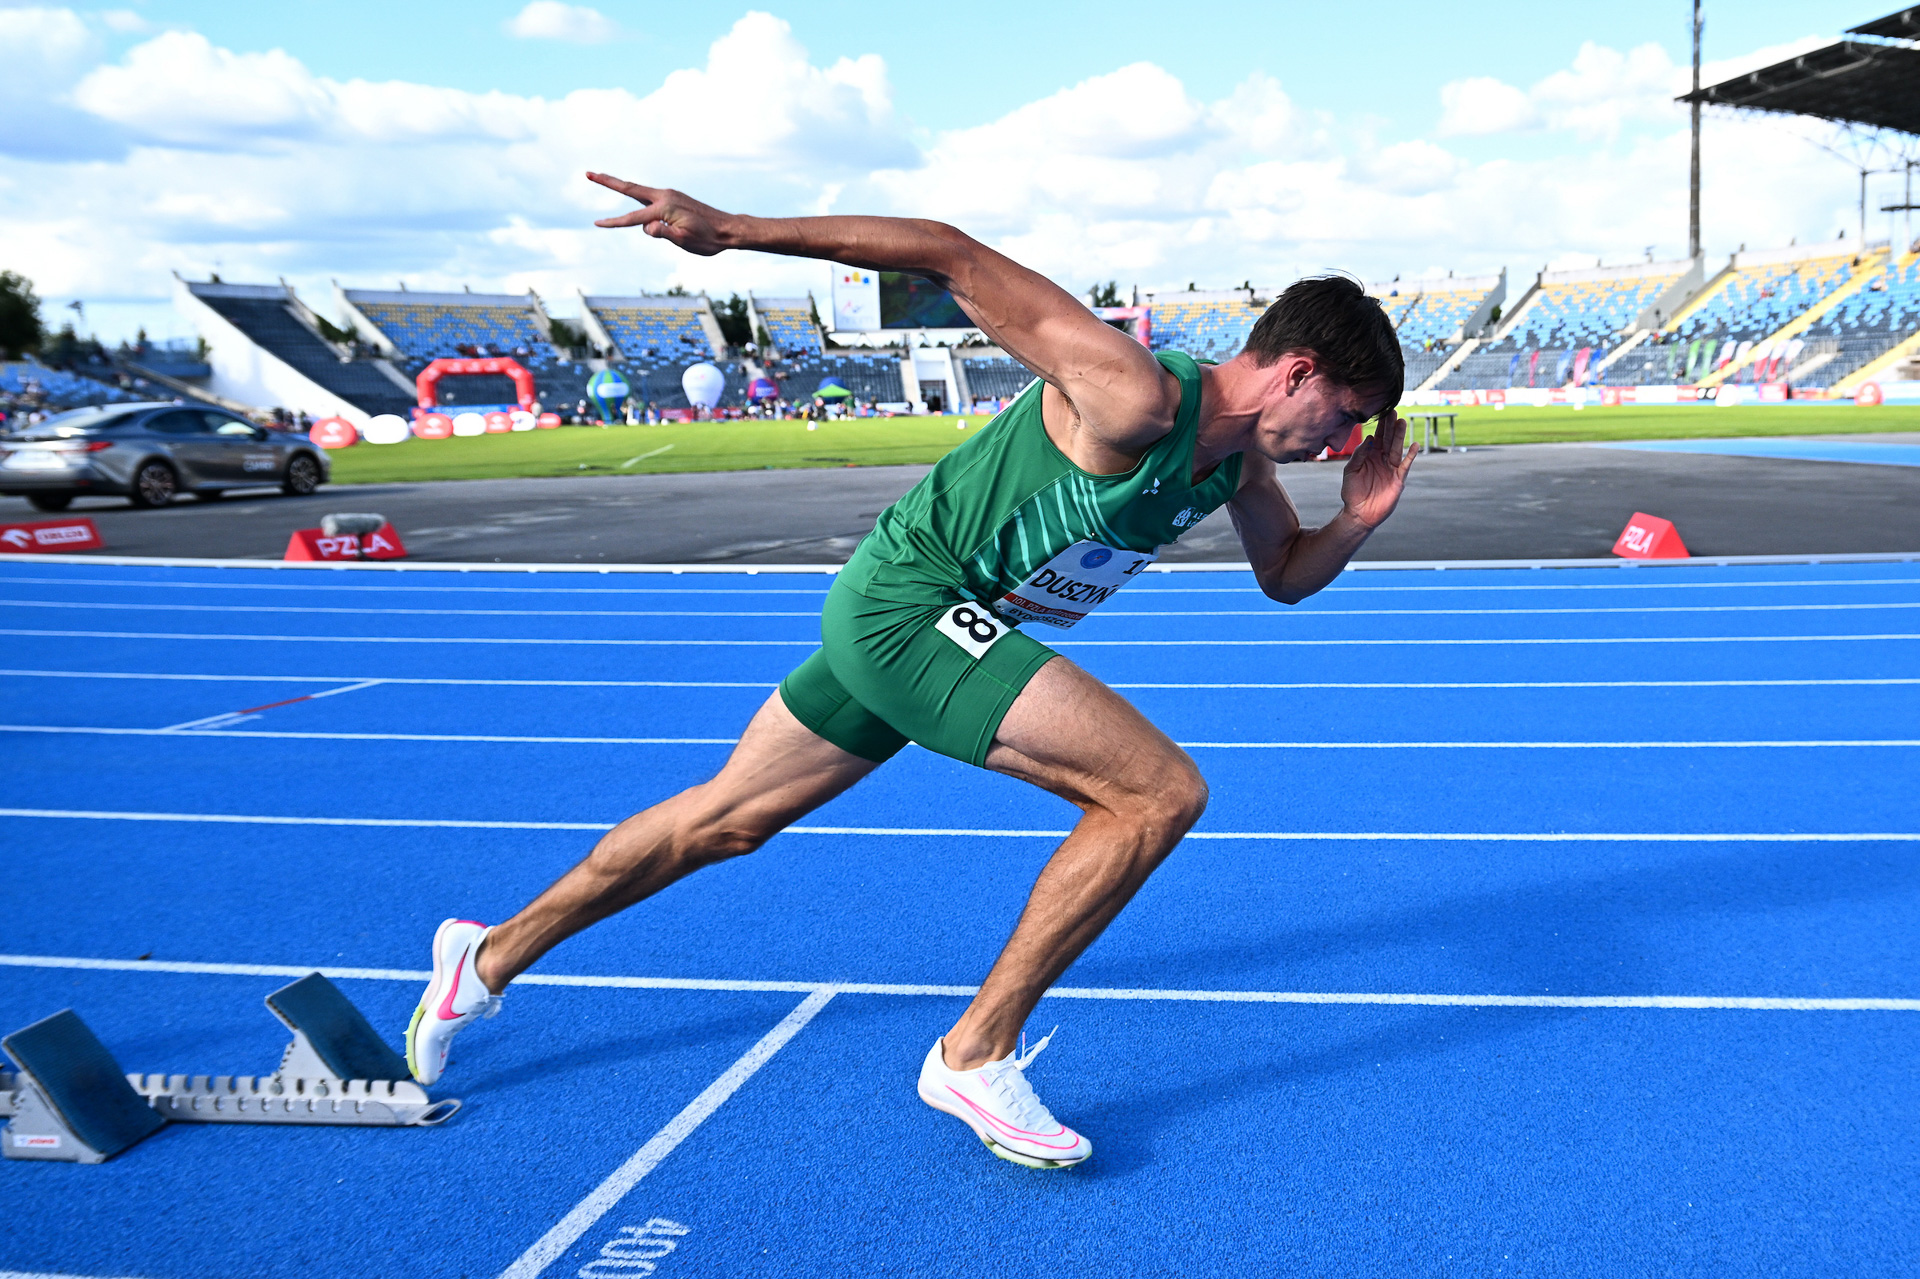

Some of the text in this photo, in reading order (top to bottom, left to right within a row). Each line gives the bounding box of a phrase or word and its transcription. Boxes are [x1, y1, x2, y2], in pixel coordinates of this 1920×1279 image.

[316, 534, 394, 557] PZLA
[1620, 525, 1655, 554] PZLA
[1008, 607, 1067, 628] BYDGOSZCZ
[1026, 602, 1046, 614] PZLA
[952, 607, 998, 643] 8
